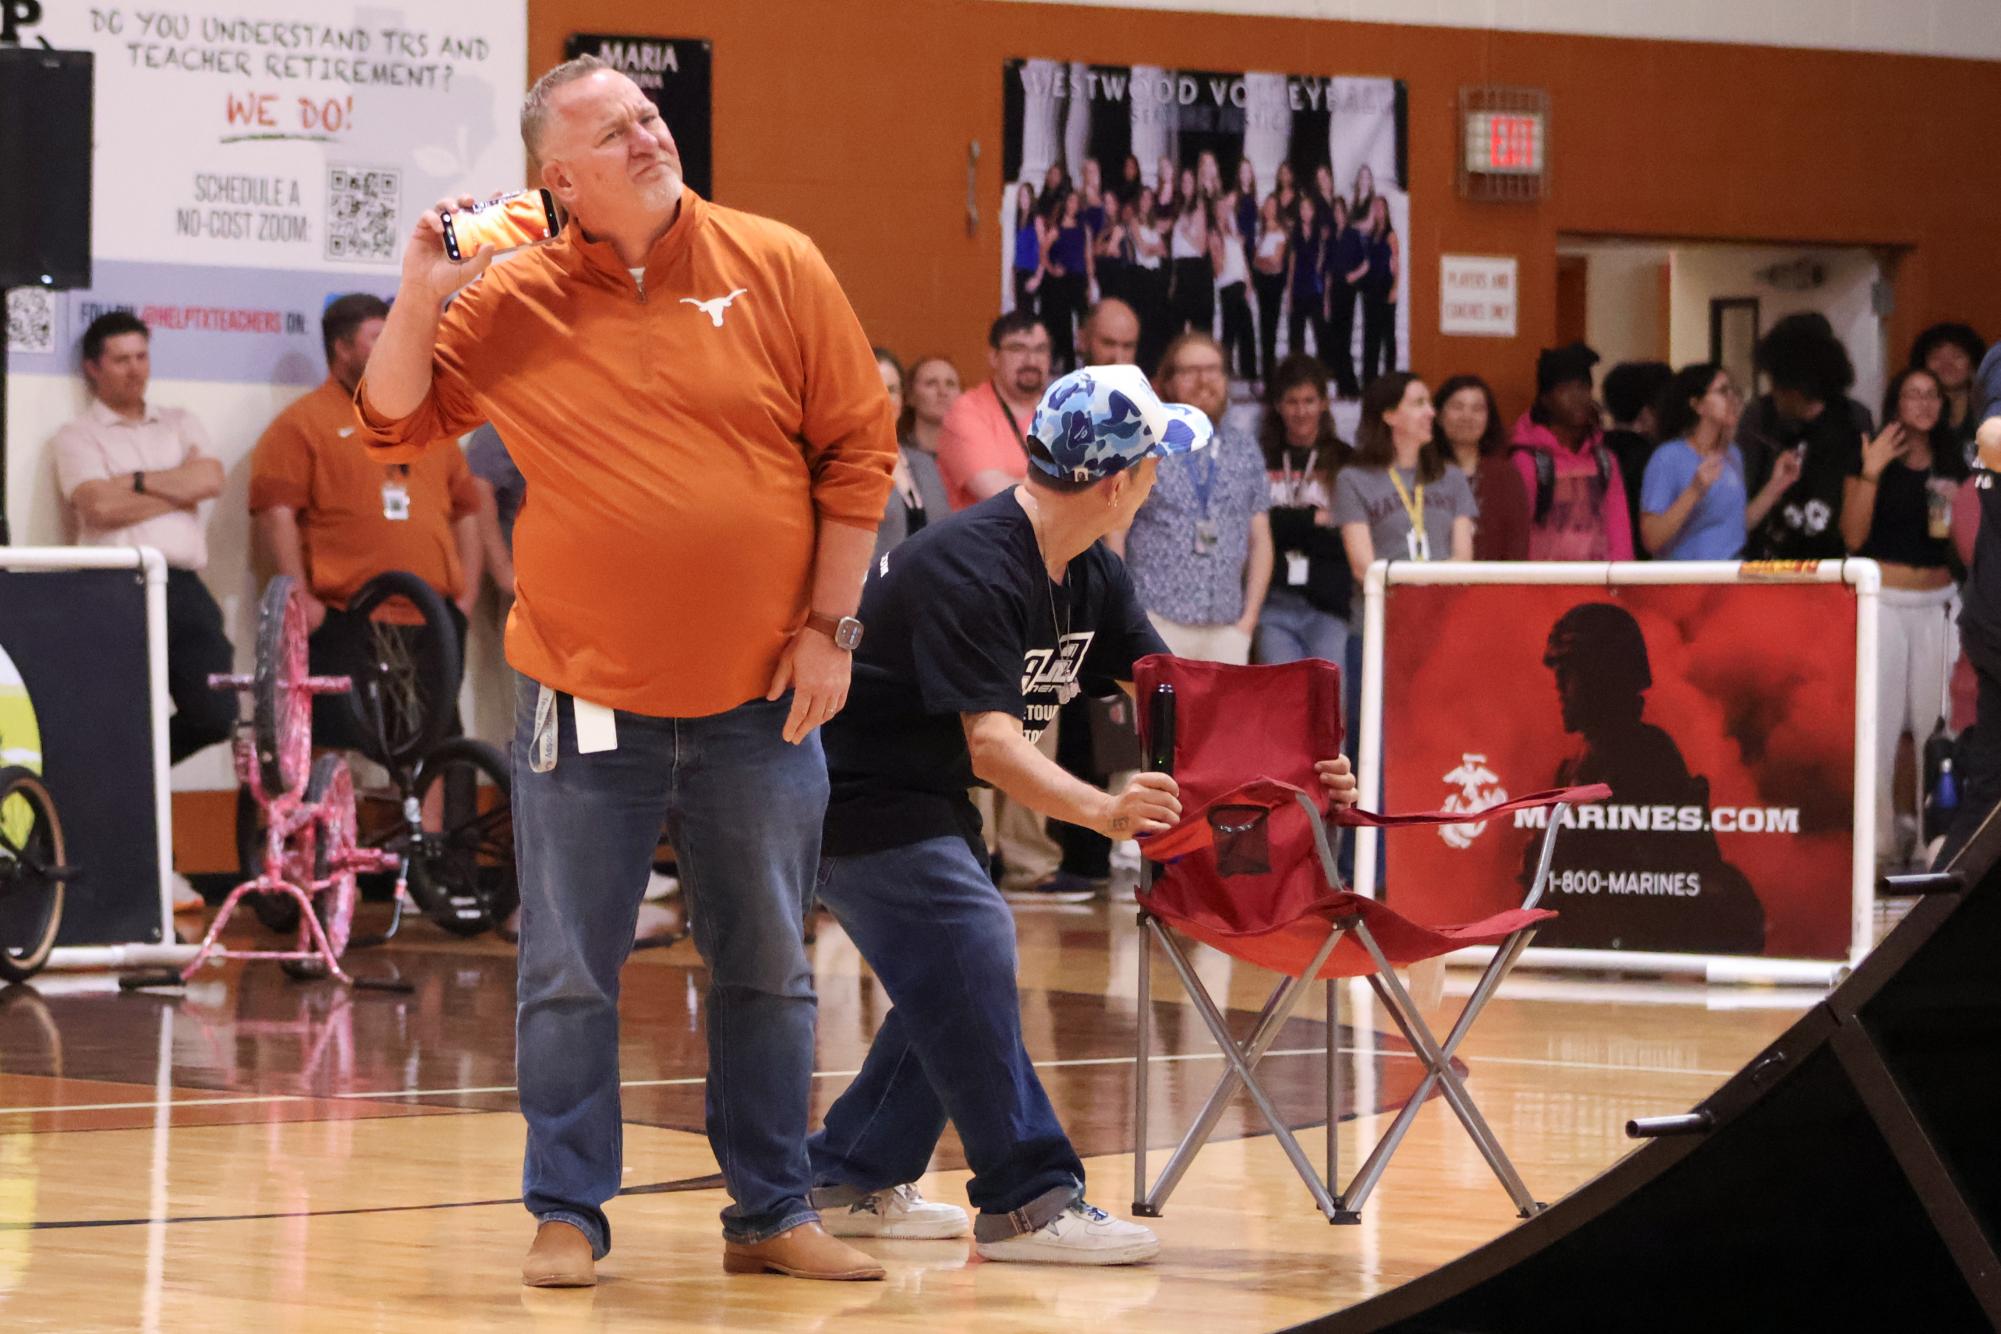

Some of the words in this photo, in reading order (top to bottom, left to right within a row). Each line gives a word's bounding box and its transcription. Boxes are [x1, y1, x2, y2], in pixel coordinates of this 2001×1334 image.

[90, 9, 123, 34] DO
[136, 12, 189, 40] YOU
[203, 17, 369, 51] UNDERSTAND
[381, 28, 429, 57] TRS
[440, 36, 489, 61] AND
[127, 43, 251, 76] TEACHER
[265, 54, 453, 93] RETIREMENT?
[601, 42, 678, 72] MARIA
[1019, 67, 1198, 105] WESTWOOD
[226, 92, 279, 126] WE
[299, 96, 353, 132] DO!
[1490, 117, 1534, 168] EXIT
[195, 174, 284, 206] SCHEDULE
[289, 180, 300, 206] A
[177, 208, 253, 239] NO-COST
[1513, 804, 1800, 833] MARINES.COM
[1548, 870, 1700, 897] 1-800-MARINES
